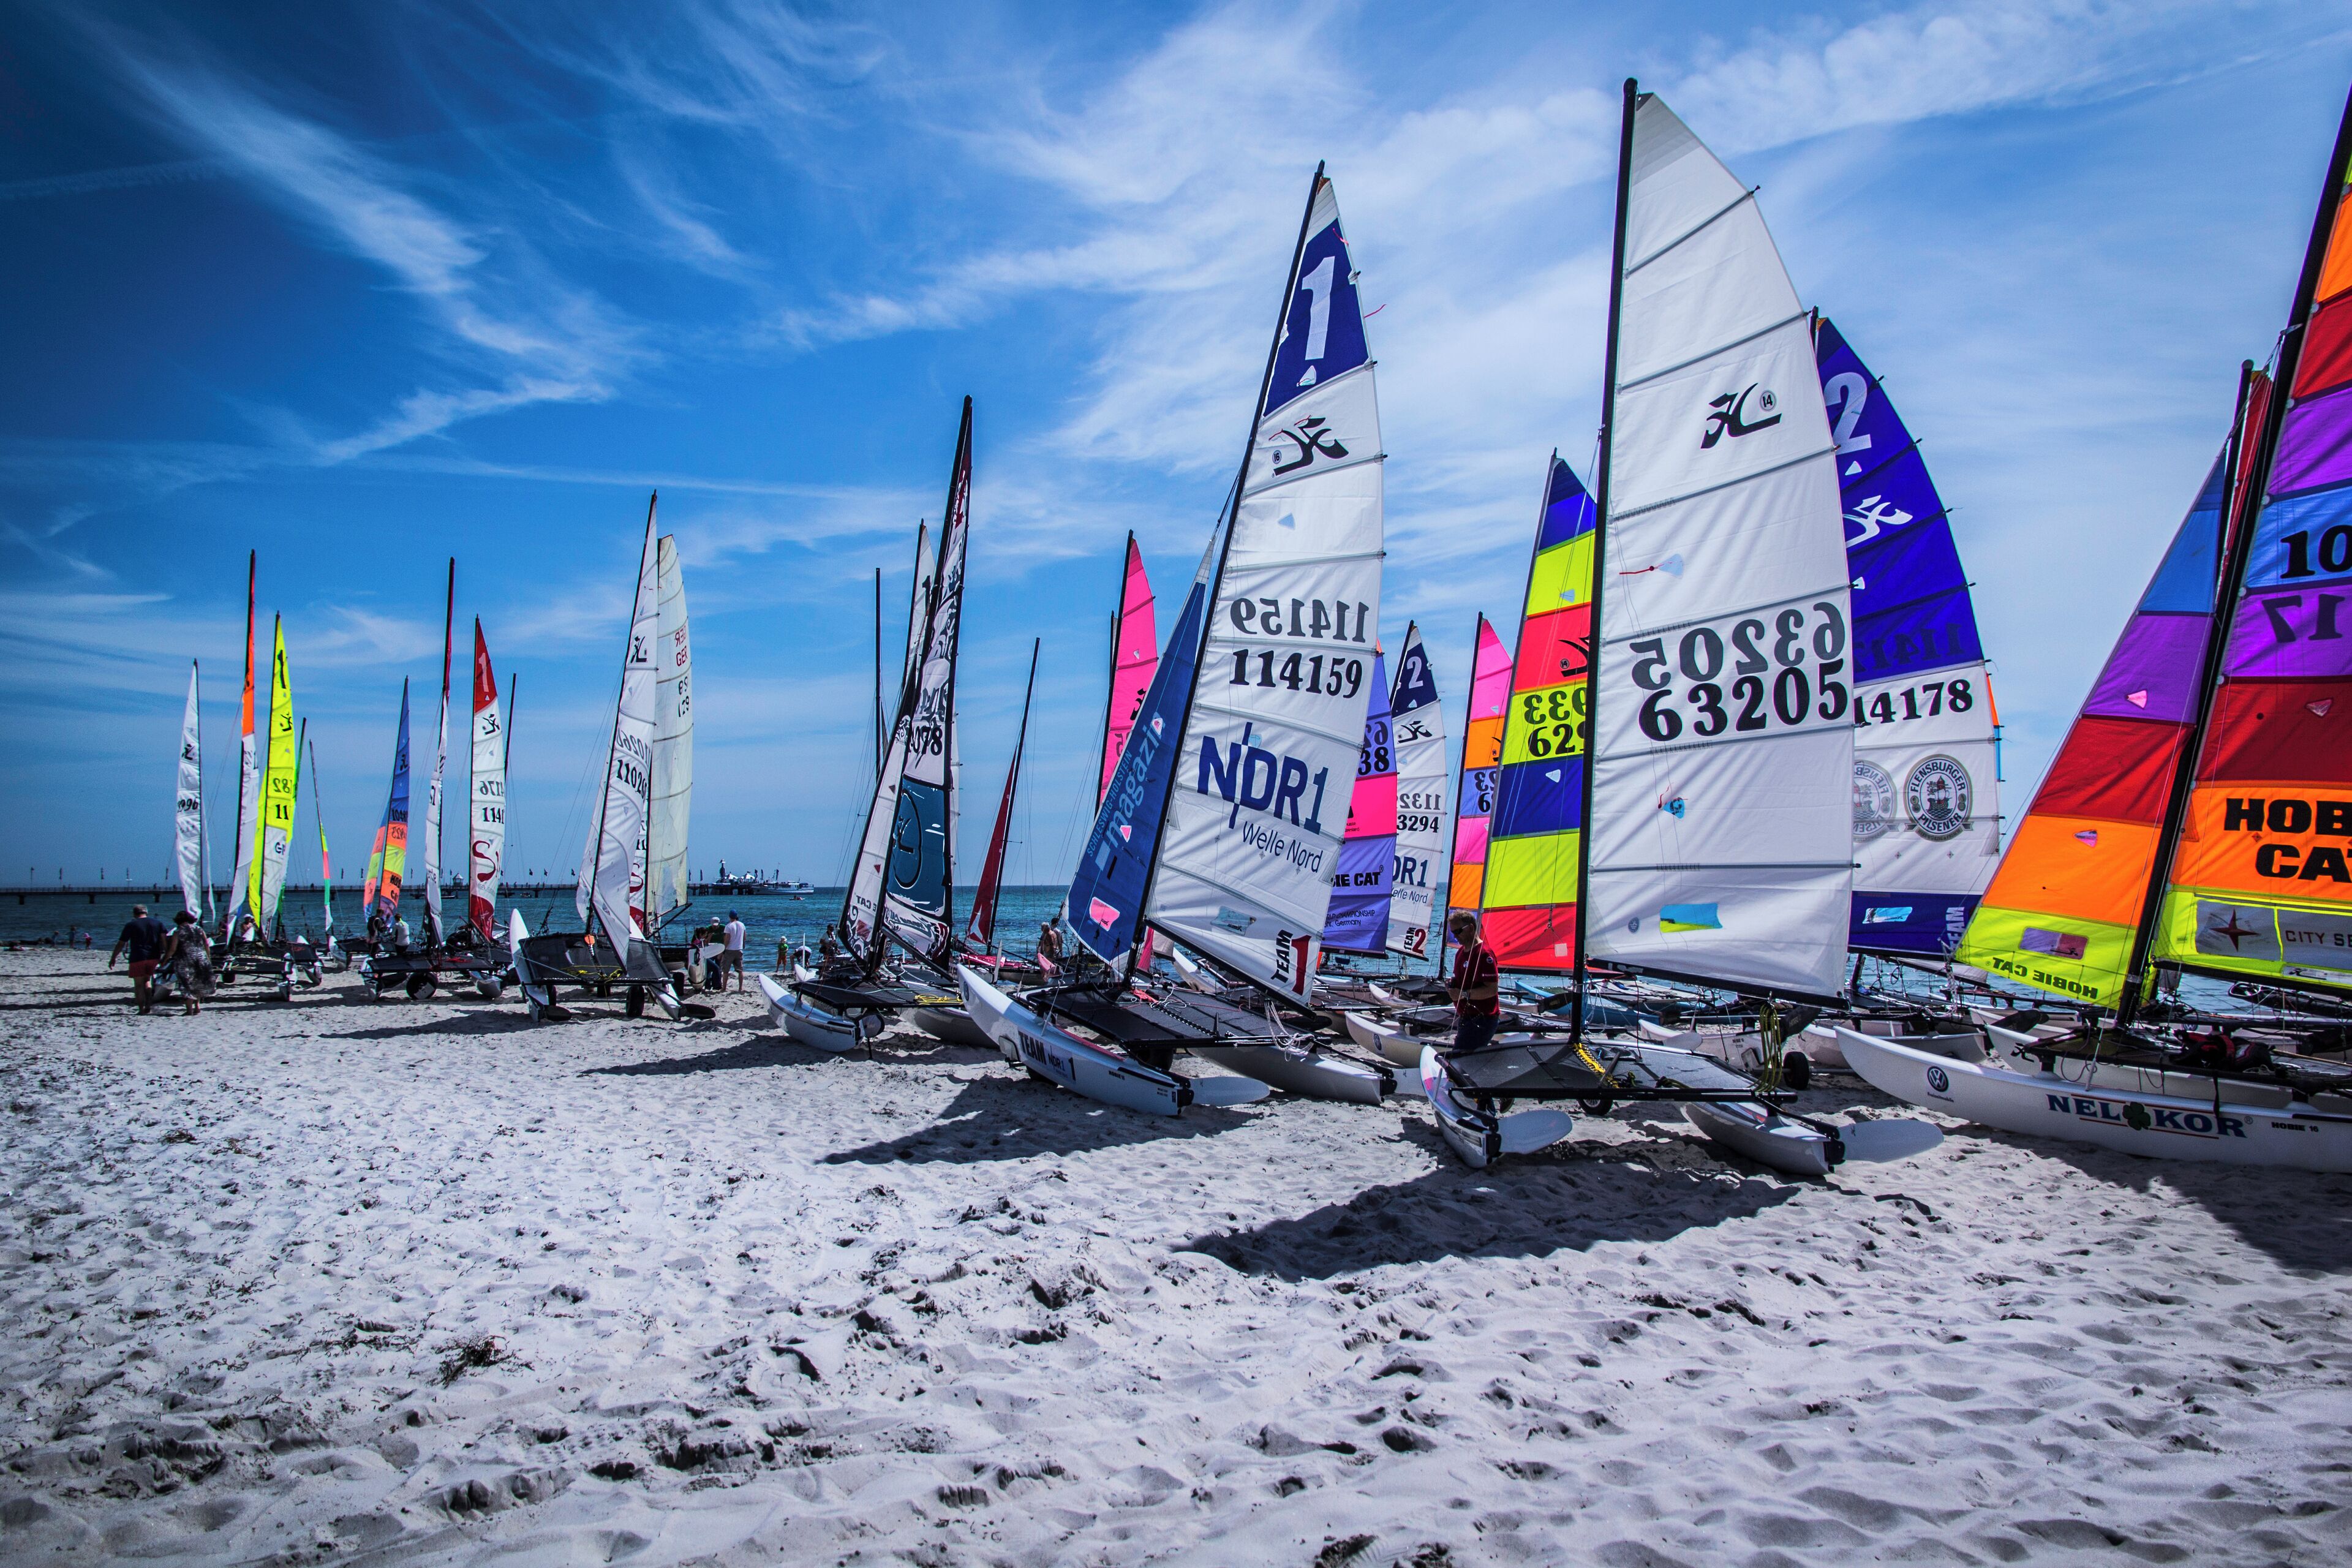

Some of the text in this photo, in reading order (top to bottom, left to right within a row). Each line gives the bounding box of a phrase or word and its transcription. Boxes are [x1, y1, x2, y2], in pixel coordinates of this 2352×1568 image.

[1302, 256, 1335, 361] 1
[1763, 394, 1773, 407] 14
[1823, 372, 1872, 456] 2
[478, 652, 489, 692] 1
[1229, 649, 1363, 698] 114159
[1407, 656, 1423, 689] 2
[1638, 658, 1848, 742] 63205
[1910, 761, 1966, 793] FLENSBURGER
[1087, 750, 1132, 857] SCHLESWIG-HOLSTEIN
[1918, 813, 1963, 832] PILSENER
[1243, 820, 1322, 873] Welle Nord
[2255, 843, 2352, 883] CA
[1354, 872, 1380, 886] CAT
[1409, 891, 1428, 903] Nord
[1404, 927, 1427, 955] TEAM 2
[2285, 929, 2325, 944] CITY
[1270, 929, 1312, 996] TEAM 1
[1019, 1032, 1047, 1065] TEAM
[1069, 1057, 1076, 1081] 1
[2271, 1121, 2305, 1131] HOBIE
